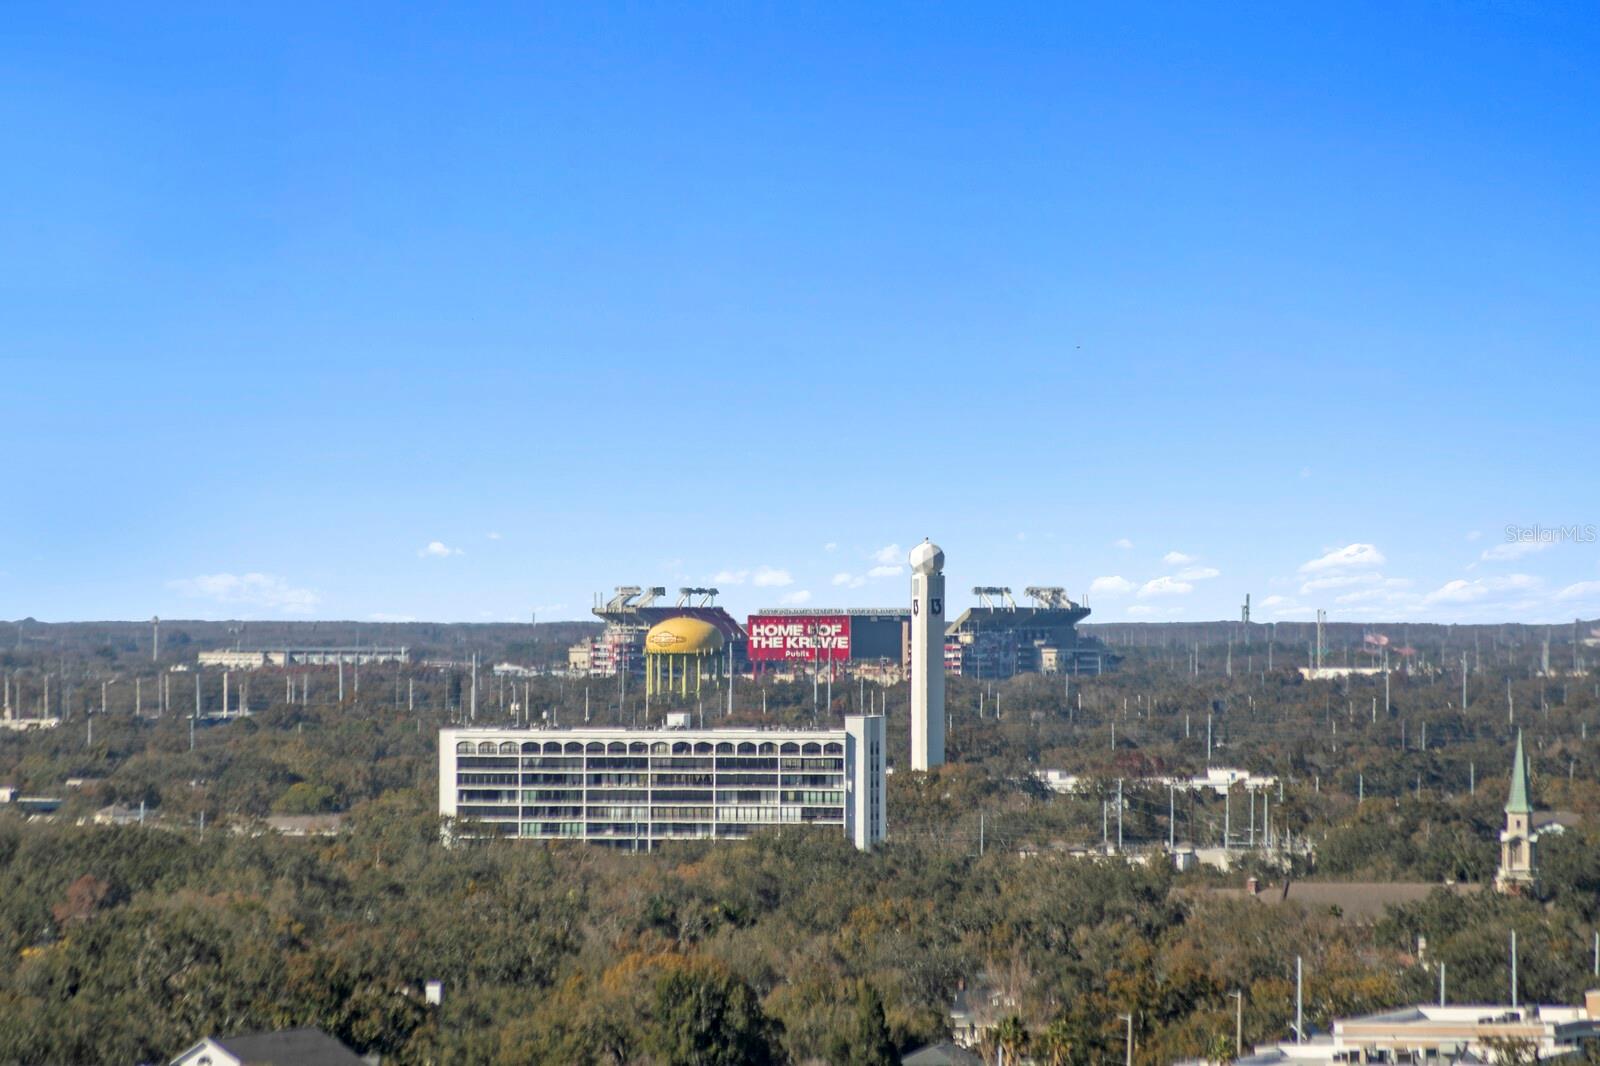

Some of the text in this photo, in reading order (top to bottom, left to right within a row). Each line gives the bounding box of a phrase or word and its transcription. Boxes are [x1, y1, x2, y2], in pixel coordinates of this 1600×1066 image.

[752, 624, 842, 637] HOME OF
[749, 636, 784, 649] THE
